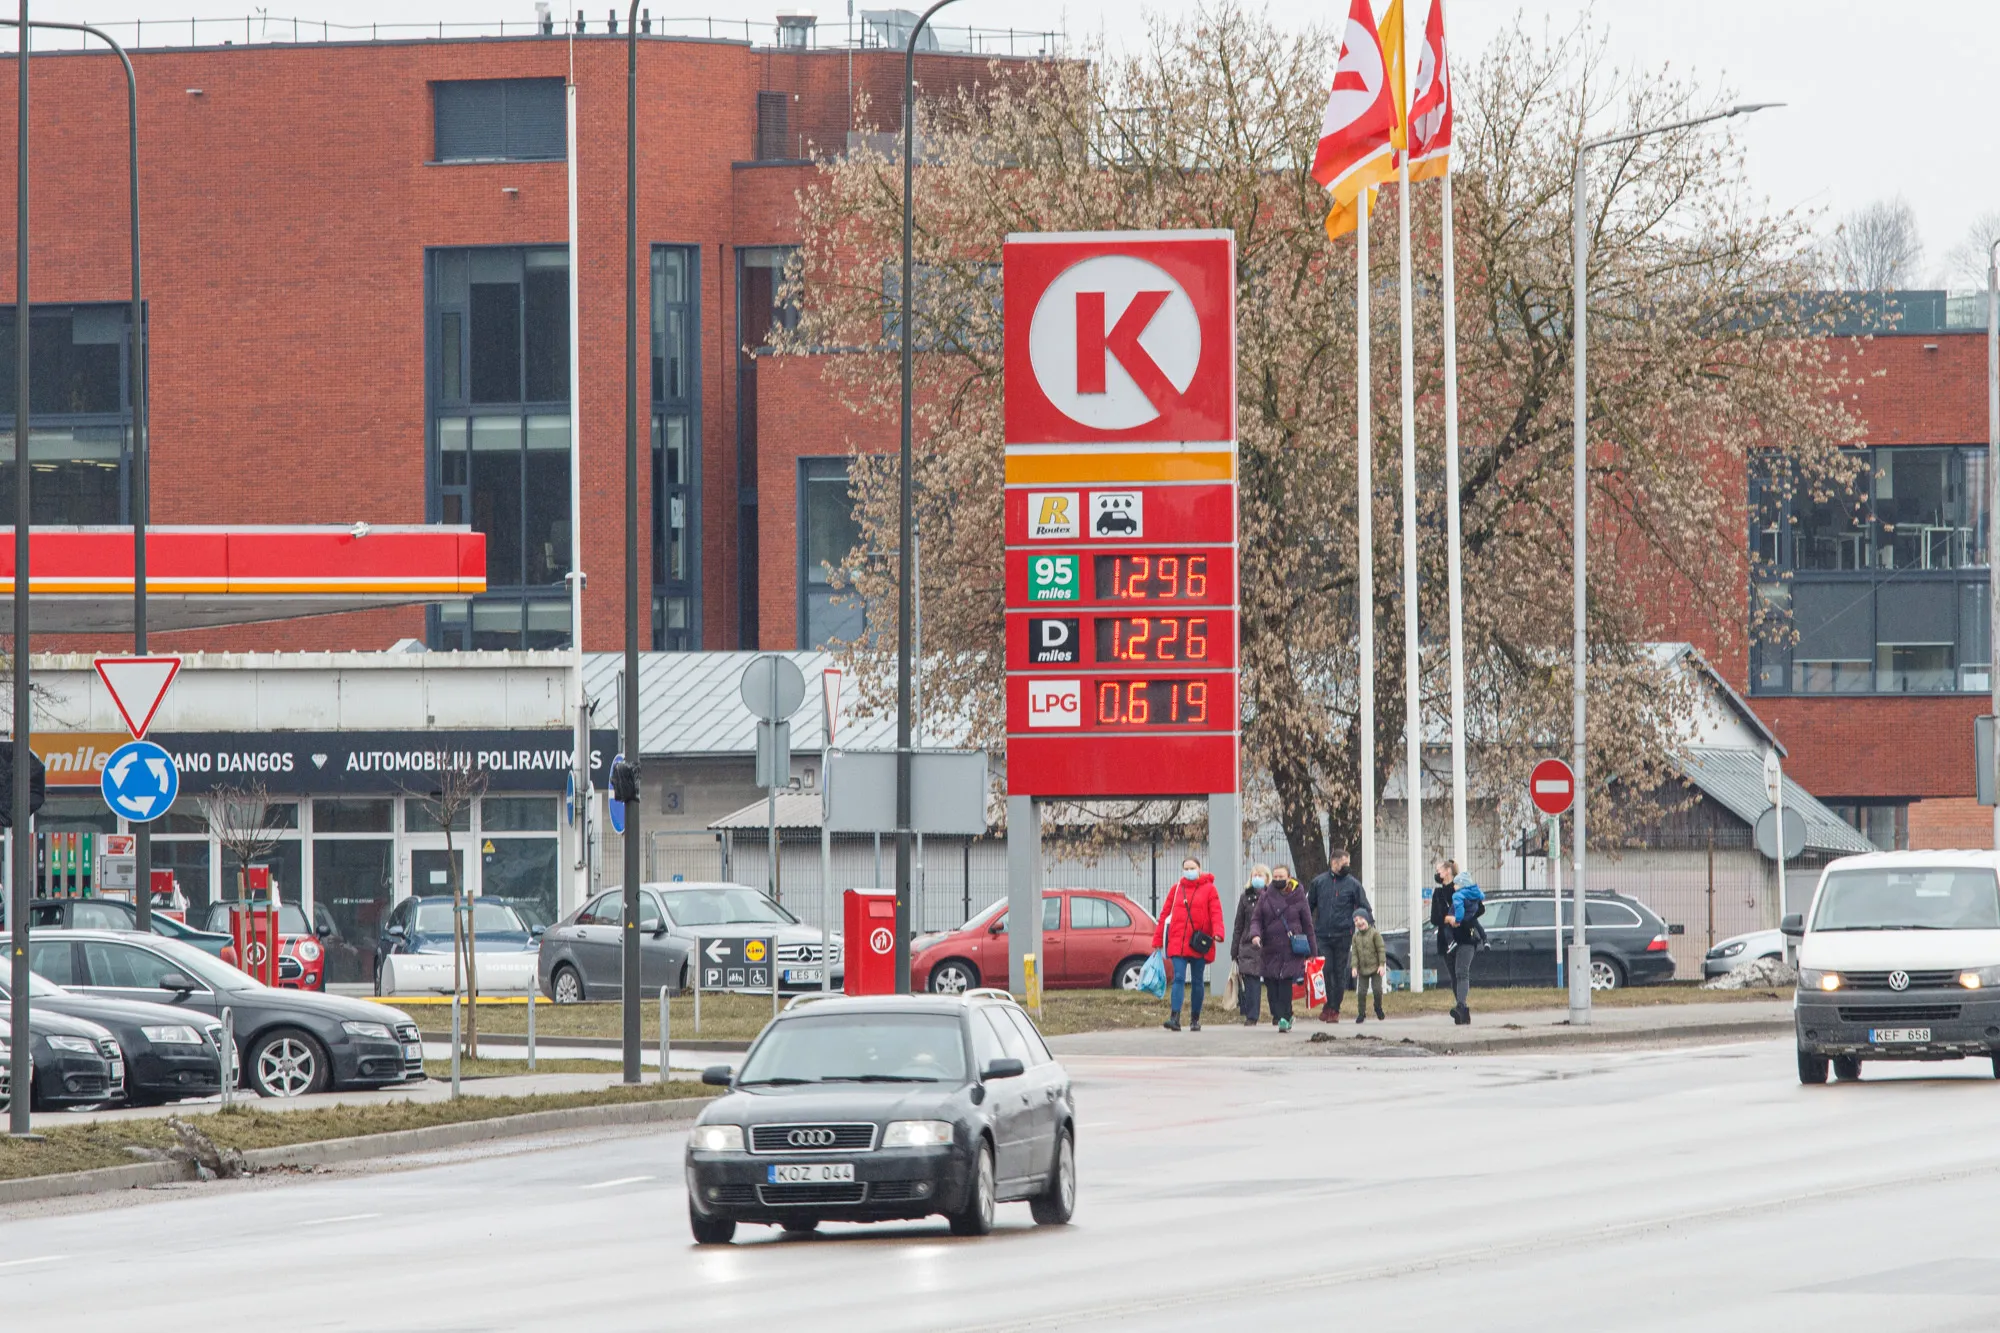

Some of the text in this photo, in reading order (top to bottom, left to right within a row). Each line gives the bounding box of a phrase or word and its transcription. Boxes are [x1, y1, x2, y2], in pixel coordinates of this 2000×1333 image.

[1076, 290, 1184, 412] K
[1036, 526, 1070, 535] Routex
[1035, 557, 1073, 585] 95
[1114, 556, 1206, 599] 1.296
[1037, 587, 1072, 599] miles
[1042, 620, 1069, 647] D
[1114, 617, 1206, 660] 1.226
[1037, 649, 1072, 662] miles
[1031, 693, 1077, 713] LPG
[45, 747, 106, 772] mile
[168, 750, 602, 775] ANO DANGOS AUTOMOBILIŲ POLIRAVIMS
[667, 792, 679, 809] 3
[707, 970, 719, 986] P
[1876, 1029, 1929, 1041] KEF 658
[777, 1166, 851, 1181] KOZ 044
